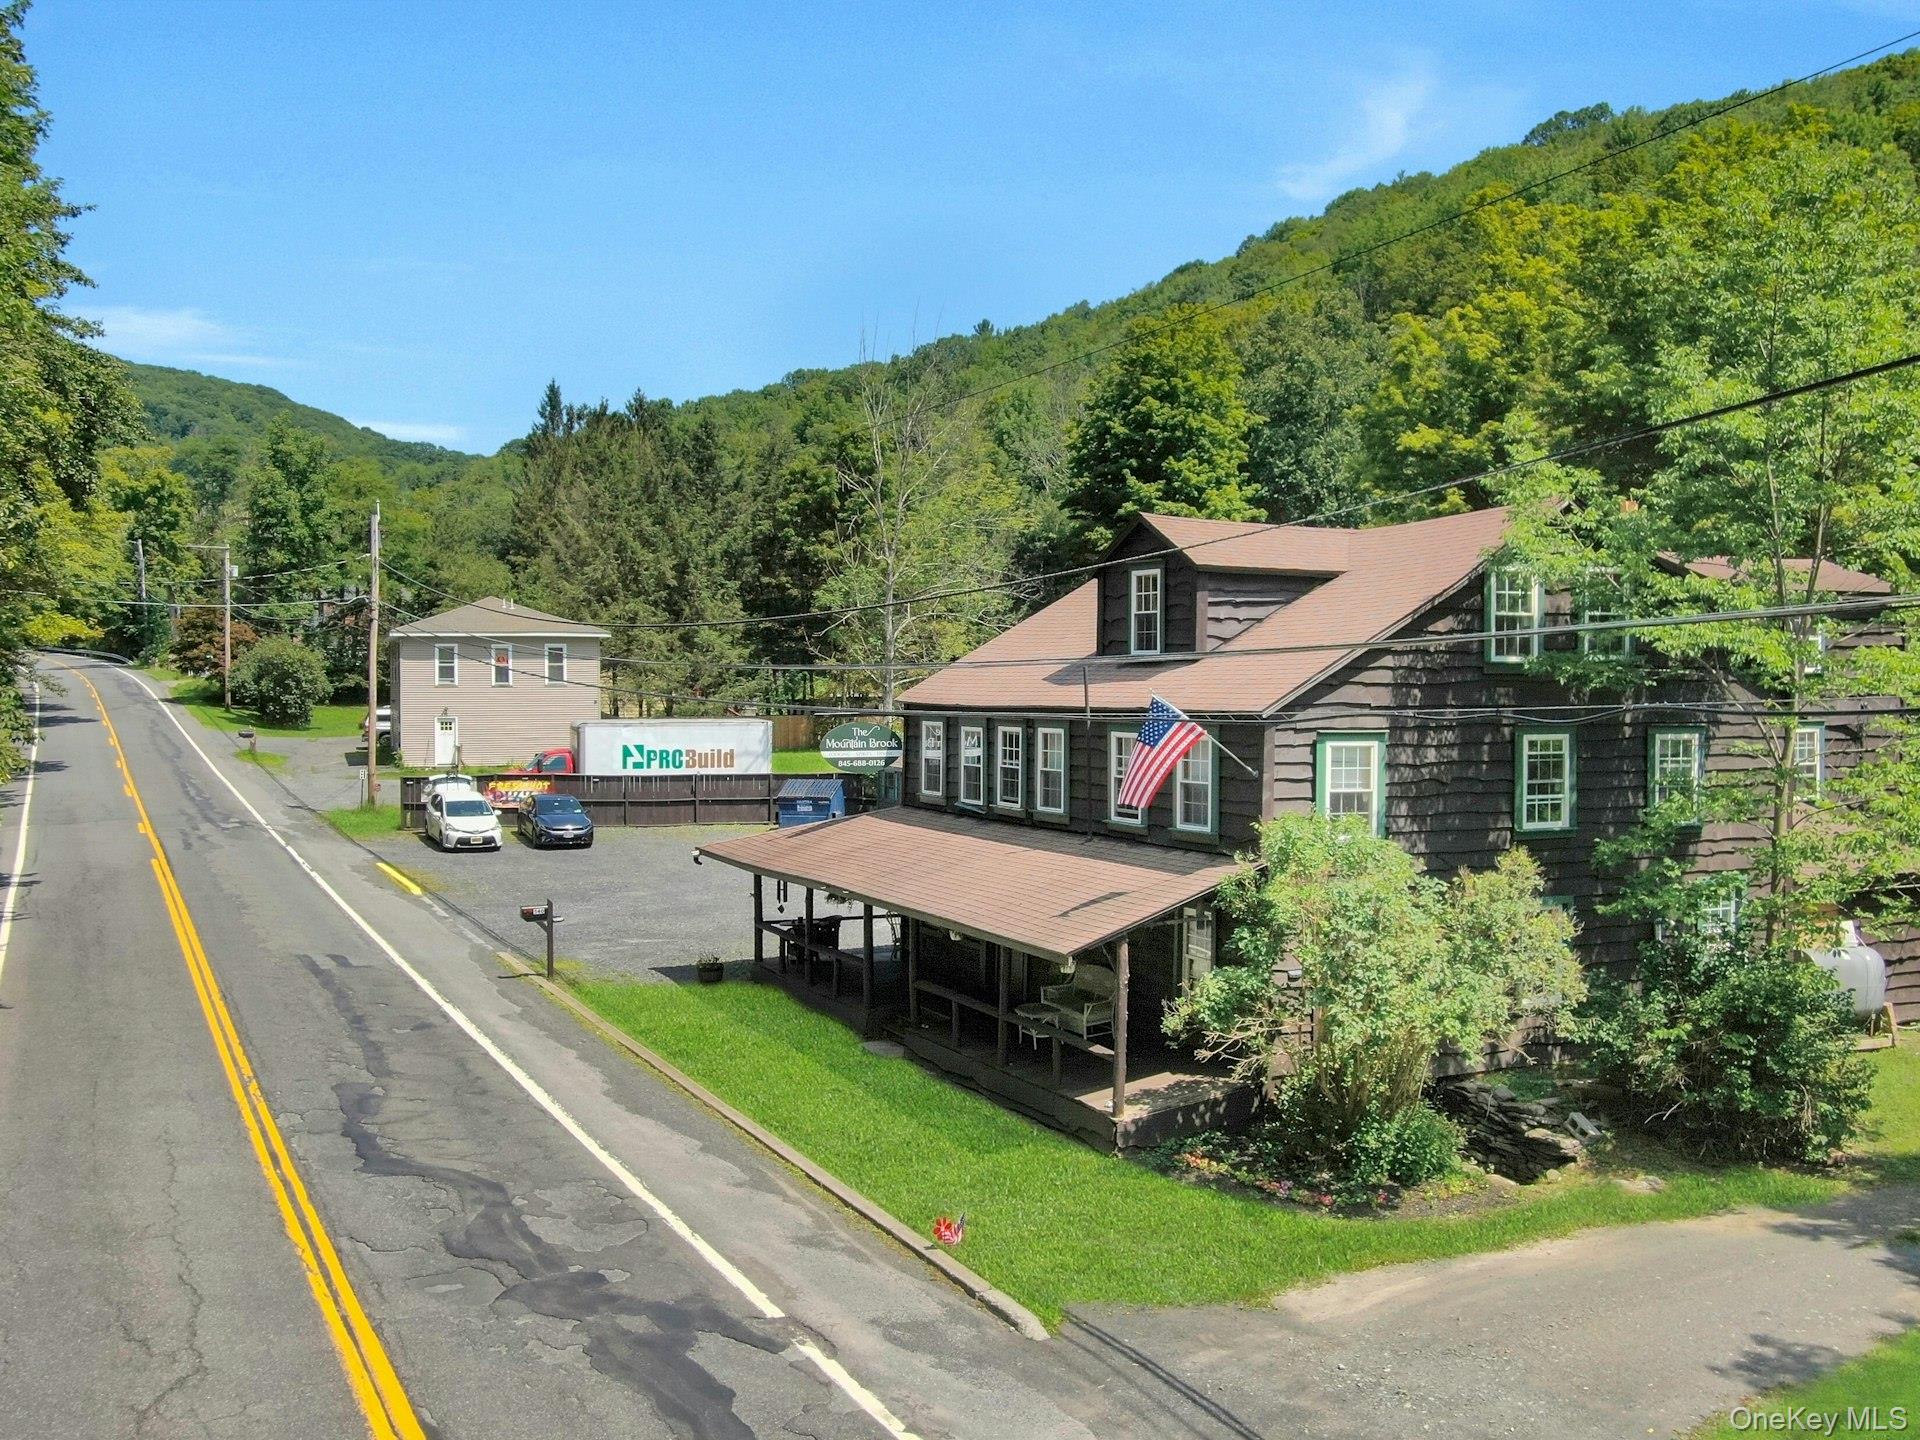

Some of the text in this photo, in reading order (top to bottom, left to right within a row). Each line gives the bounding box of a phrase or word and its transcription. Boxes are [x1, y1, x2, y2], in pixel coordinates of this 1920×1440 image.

[852, 726, 880, 736] The
[826, 737, 897, 749] Mountain Brook
